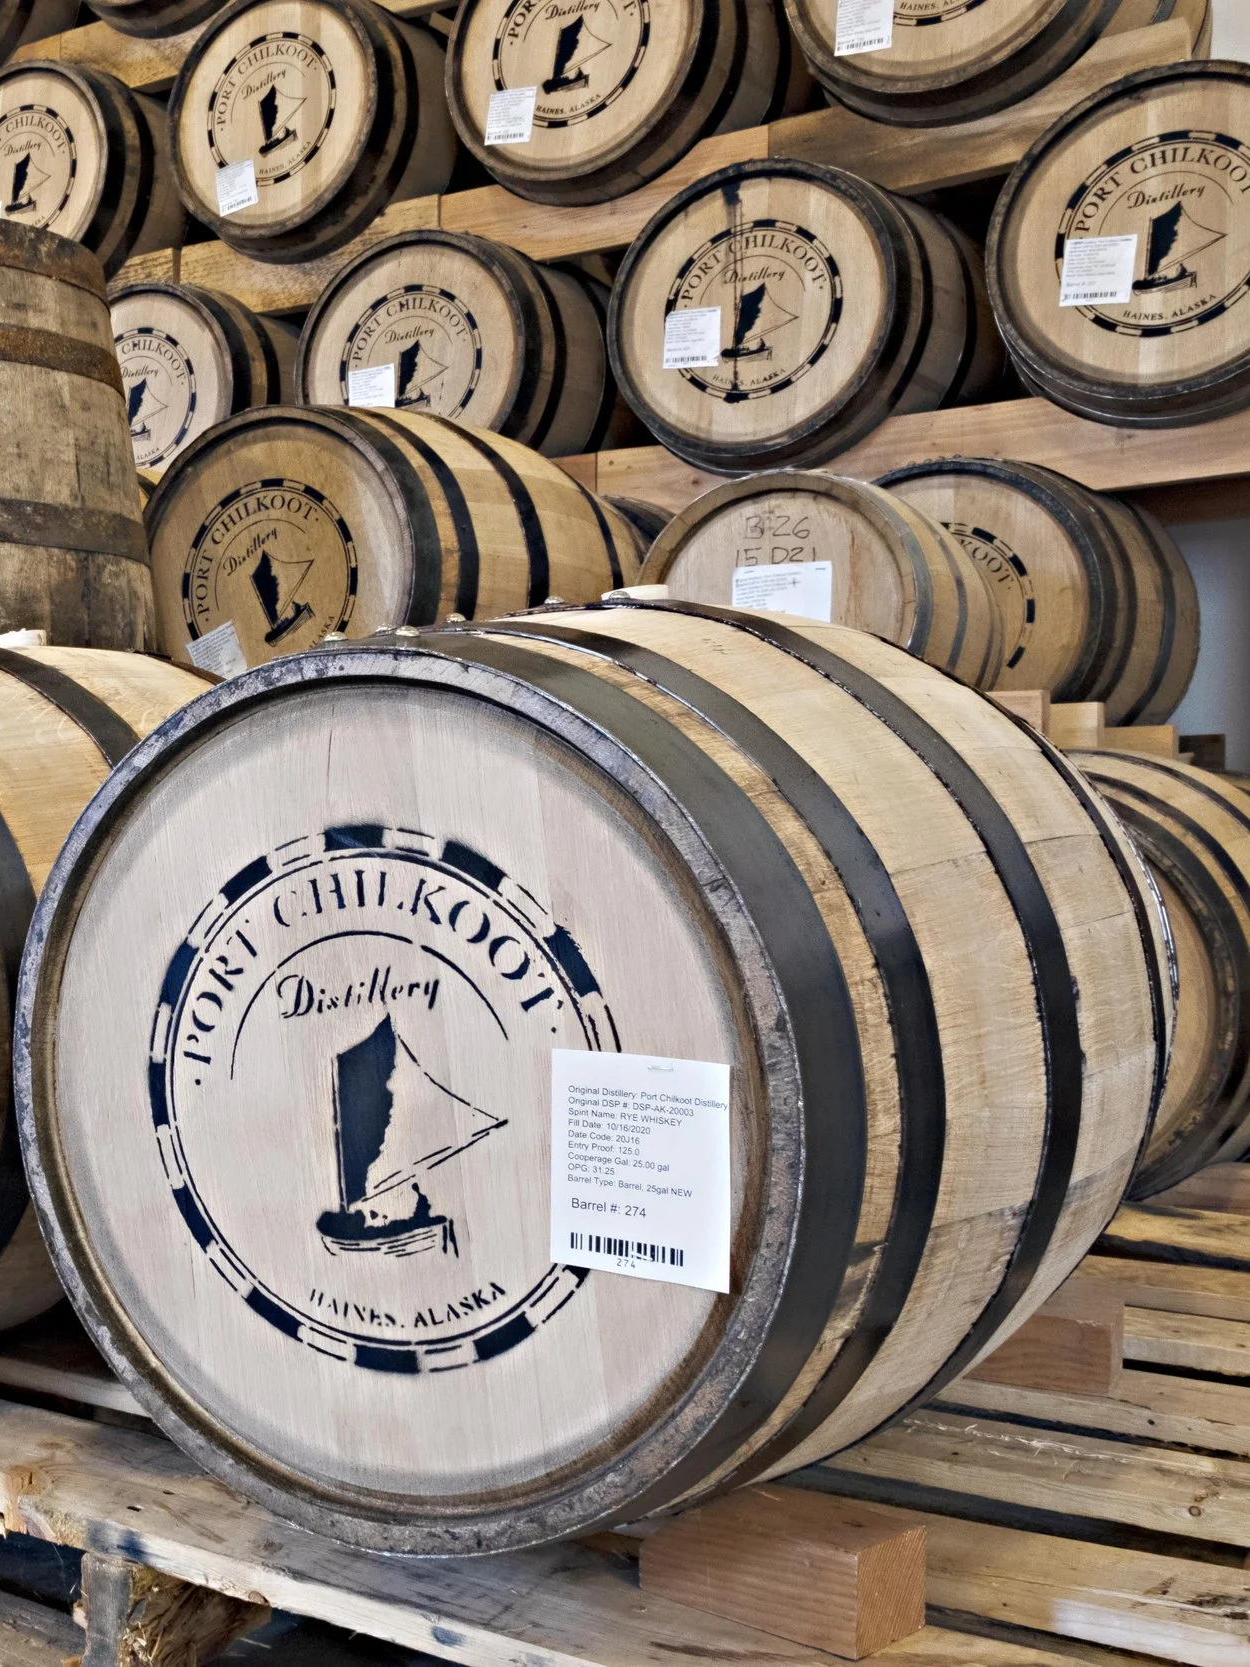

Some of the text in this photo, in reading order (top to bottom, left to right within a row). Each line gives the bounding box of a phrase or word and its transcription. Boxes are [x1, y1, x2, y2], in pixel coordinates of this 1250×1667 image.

[508, 0, 537, 39] POR
[545, 0, 600, 20] Distillery
[216, 43, 318, 126] PORT CHILKOOT
[241, 69, 287, 100] Distillery
[569, 93, 602, 113] ALASKA
[6, 115, 67, 149] CHILKOOT
[4, 140, 42, 157] Distillery
[1075, 171, 1123, 232] PORT
[1127, 183, 1205, 209] Distillery
[682, 234, 827, 301] PORT CHILKOOT
[723, 267, 786, 284] Distillery
[1171, 294, 1217, 319] ALASKA
[352, 297, 468, 361] PORT CHILKOOT
[384, 325, 435, 344] Distillery
[121, 339, 187, 381] CHILKOOT
[196, 494, 318, 616] PORT CHILKOOT
[223, 527, 278, 577] Distillery
[183, 869, 564, 1065] PORT CHILKOOT
[277, 966, 440, 1019] Distillery
[568, 1085, 728, 1111] Original Distillery: Port Chilkoot Distillery
[568, 1096, 600, 1106] Original
[602, 1099, 620, 1108] DSP
[633, 1102, 694, 1117] DSP-AK-20003
[568, 1108, 682, 1126] Spirit Name: RYE WHISKEY
[582, 1120, 603, 1129] Date:
[607, 1123, 650, 1134] 10/16/2020
[568, 1130, 640, 1145] Date Code: 20J16
[568, 1141, 640, 1156] Entry Proof: 125.0
[568, 1152, 612, 1164] Cooperage
[633, 1160, 655, 1169] 25.00
[657, 1164, 669, 1172] gal
[568, 1163, 615, 1175] OPG: 31.25
[567, 1174, 693, 1197] Barrel Type: Barrel, 25gal NEW
[571, 1197, 647, 1218] Barrel #: 274
[616, 1258, 636, 1268] 274
[414, 1282, 506, 1328] ALASKA
